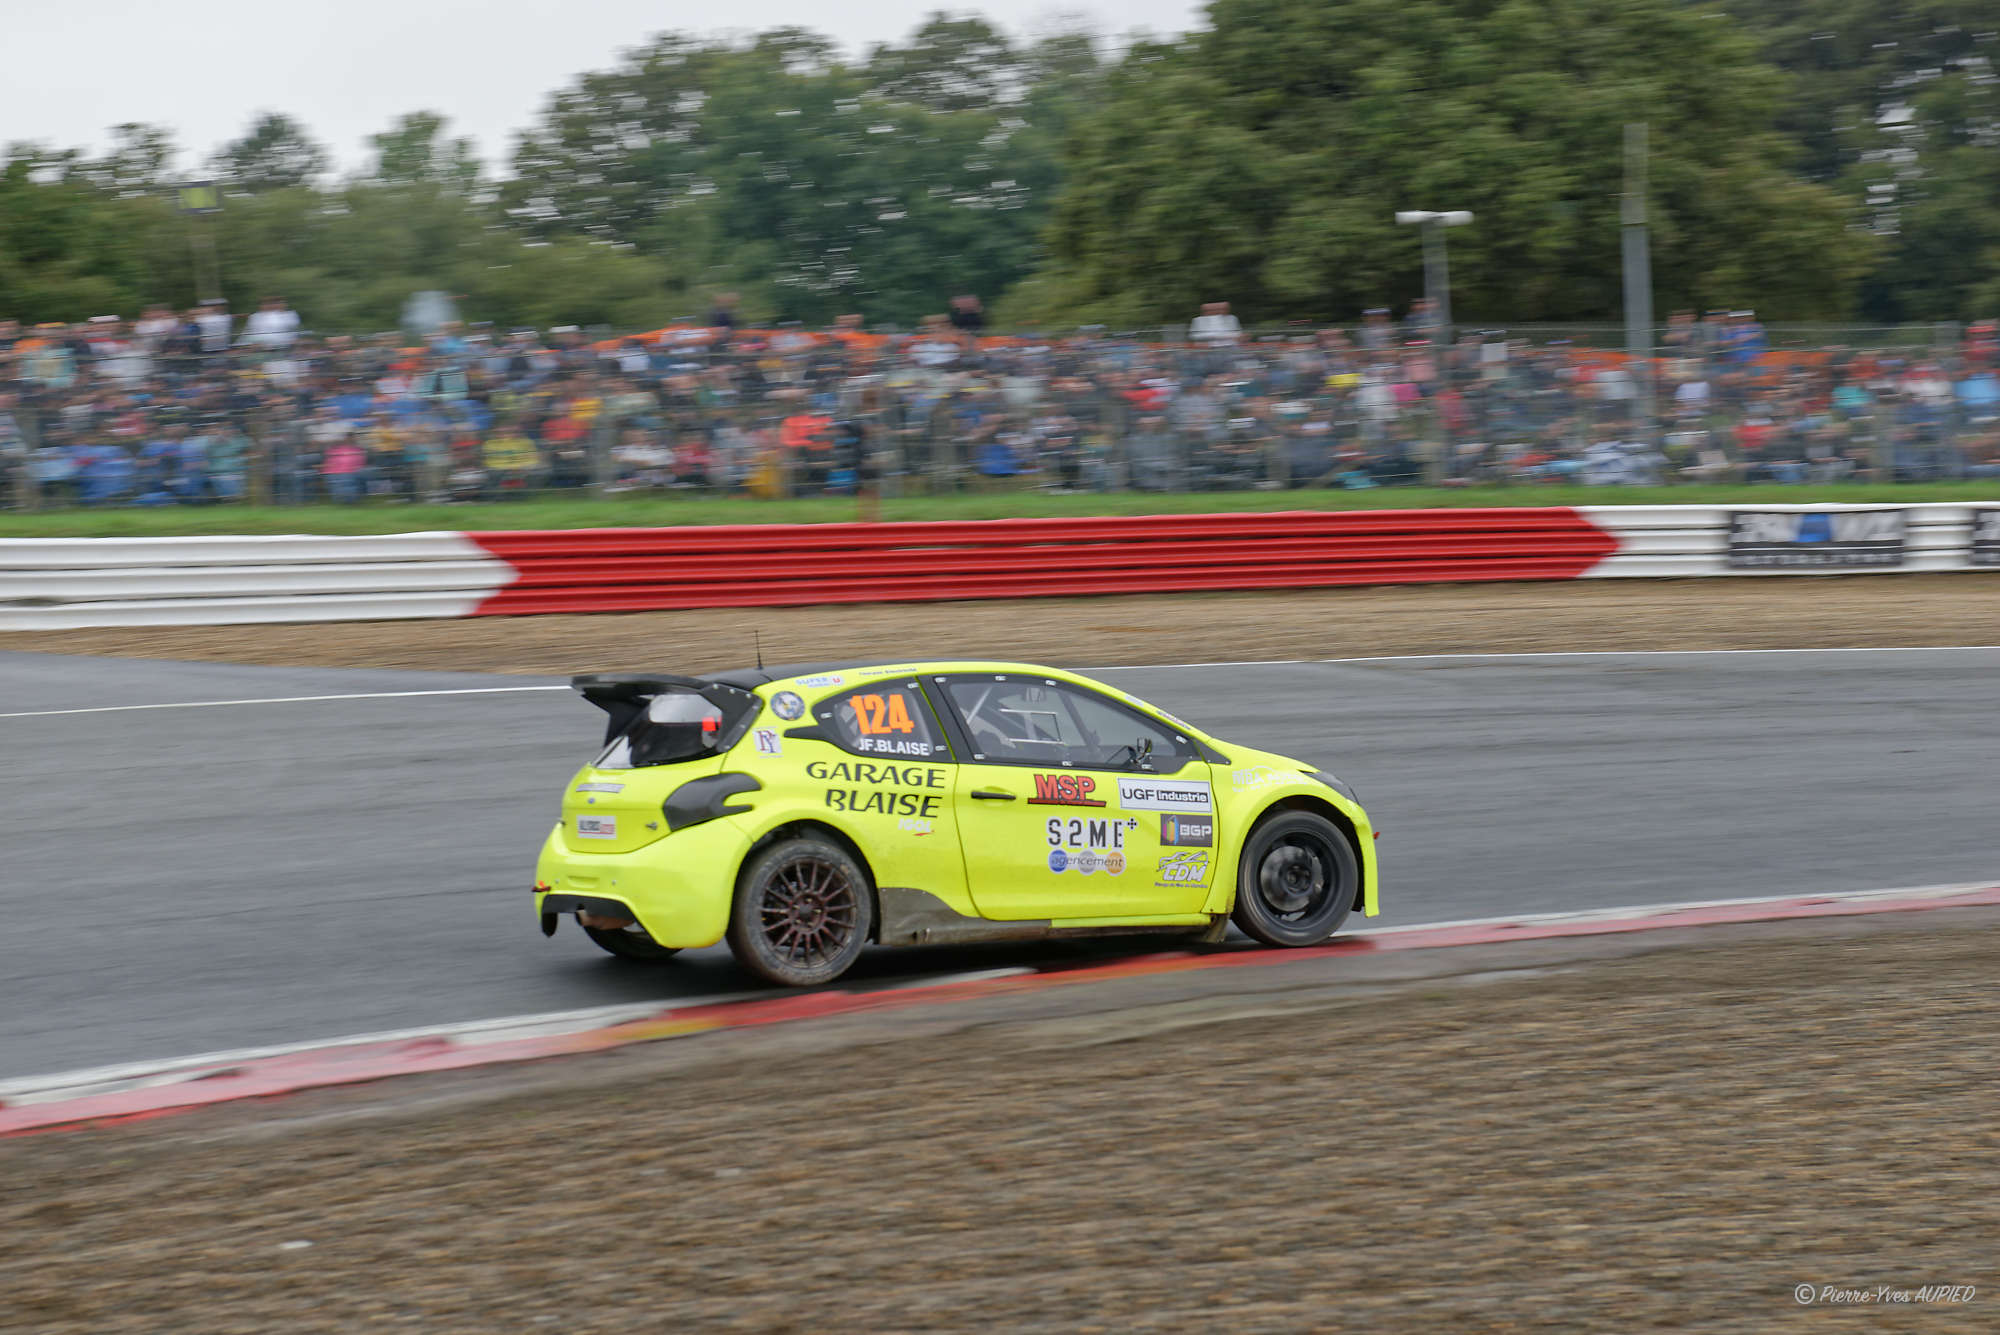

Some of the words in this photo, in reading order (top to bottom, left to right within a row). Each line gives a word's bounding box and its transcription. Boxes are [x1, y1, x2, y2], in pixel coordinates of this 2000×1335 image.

[849, 694, 915, 735] 124
[858, 738, 930, 756] JF.BLAISE
[806, 761, 946, 789] GARAGE
[1033, 774, 1096, 801] MSP
[825, 789, 943, 819] BLAISE
[1122, 788, 1155, 801] UGF
[1157, 790, 1208, 803] Industrie
[1052, 856, 1123, 867] agencement
